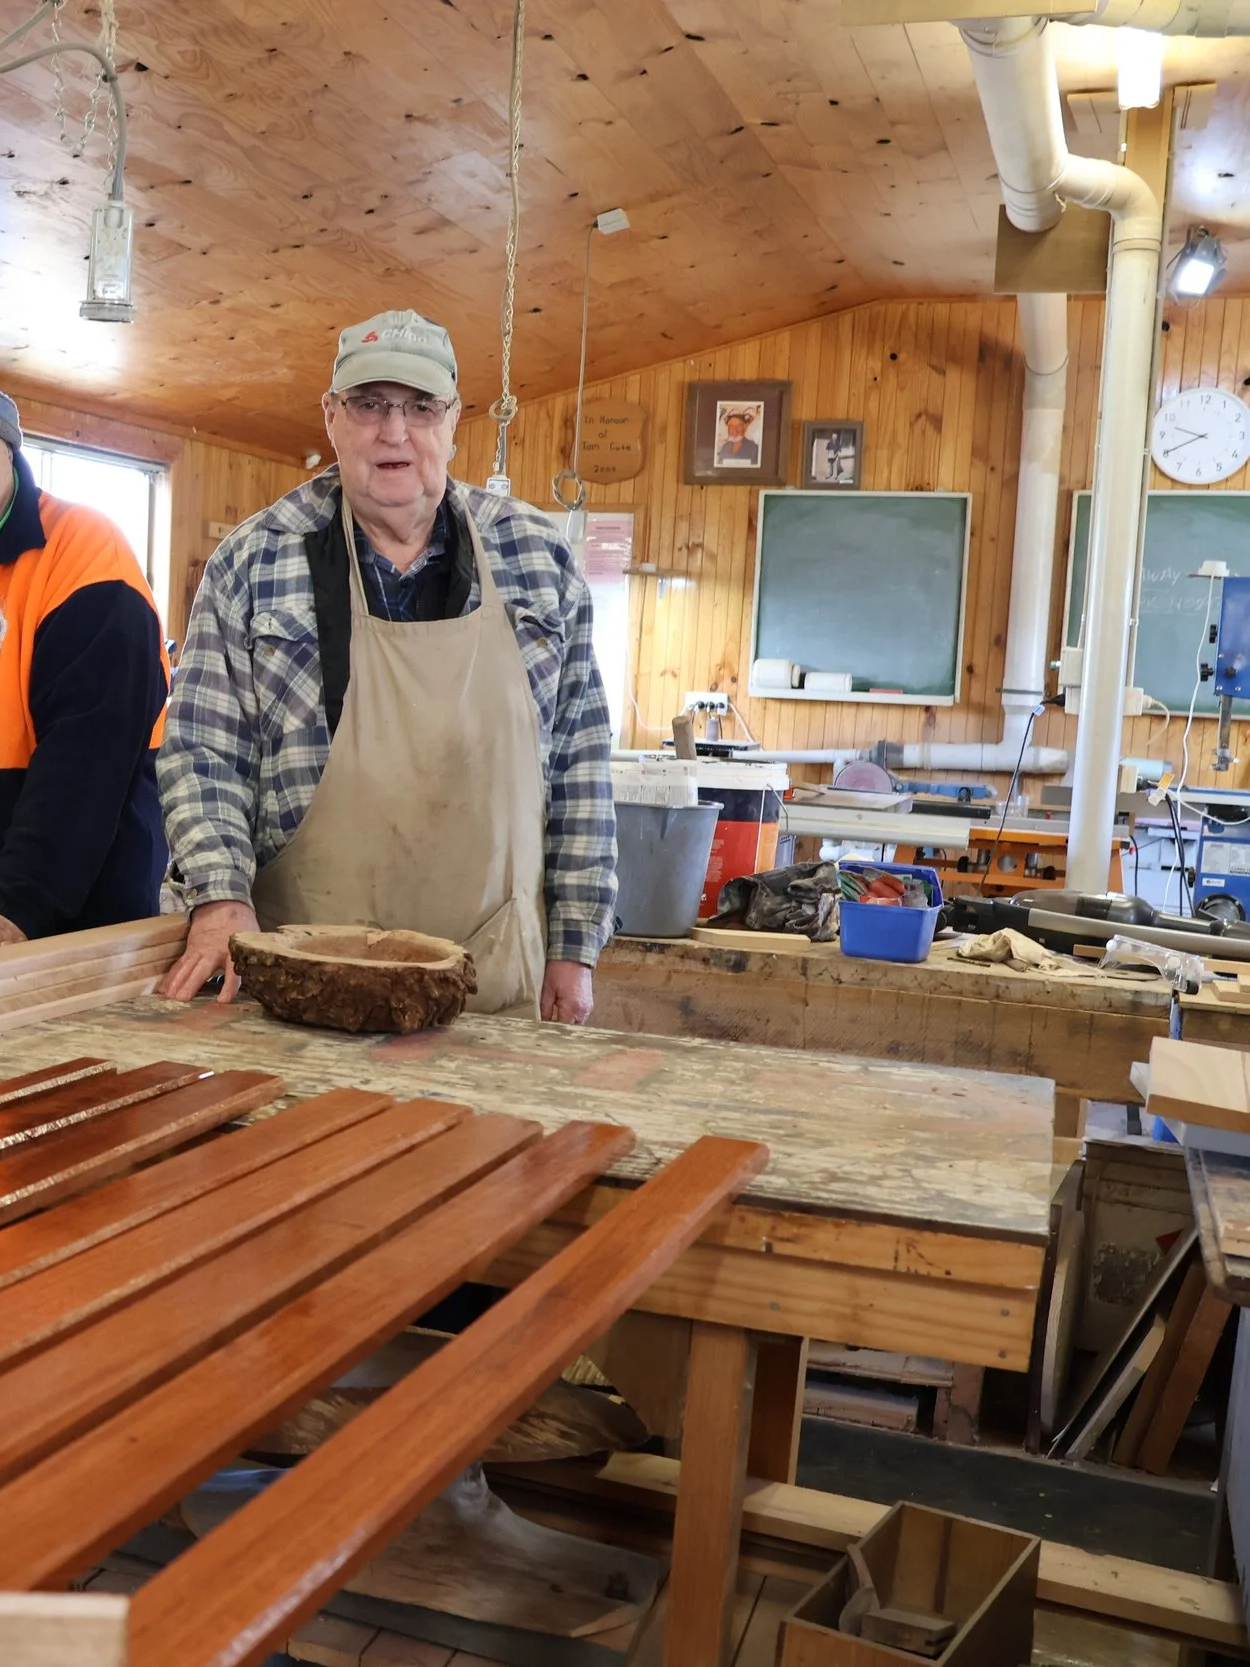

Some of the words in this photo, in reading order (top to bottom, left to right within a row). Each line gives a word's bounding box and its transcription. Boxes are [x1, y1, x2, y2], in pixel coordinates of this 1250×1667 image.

[1180, 400, 1190, 408] 11
[1200, 395, 1211, 404] 12
[1222, 400, 1226, 409] 1
[1164, 413, 1176, 422] 10
[1235, 413, 1242, 422] 2
[1159, 431, 1166, 440] 9
[1239, 431, 1245, 440] 3
[1163, 449, 1170, 458] 8
[1232, 449, 1238, 458] 4
[1176, 462, 1182, 472] 7
[1216, 463, 1222, 472] 5
[1195, 467, 1201, 477] 6
